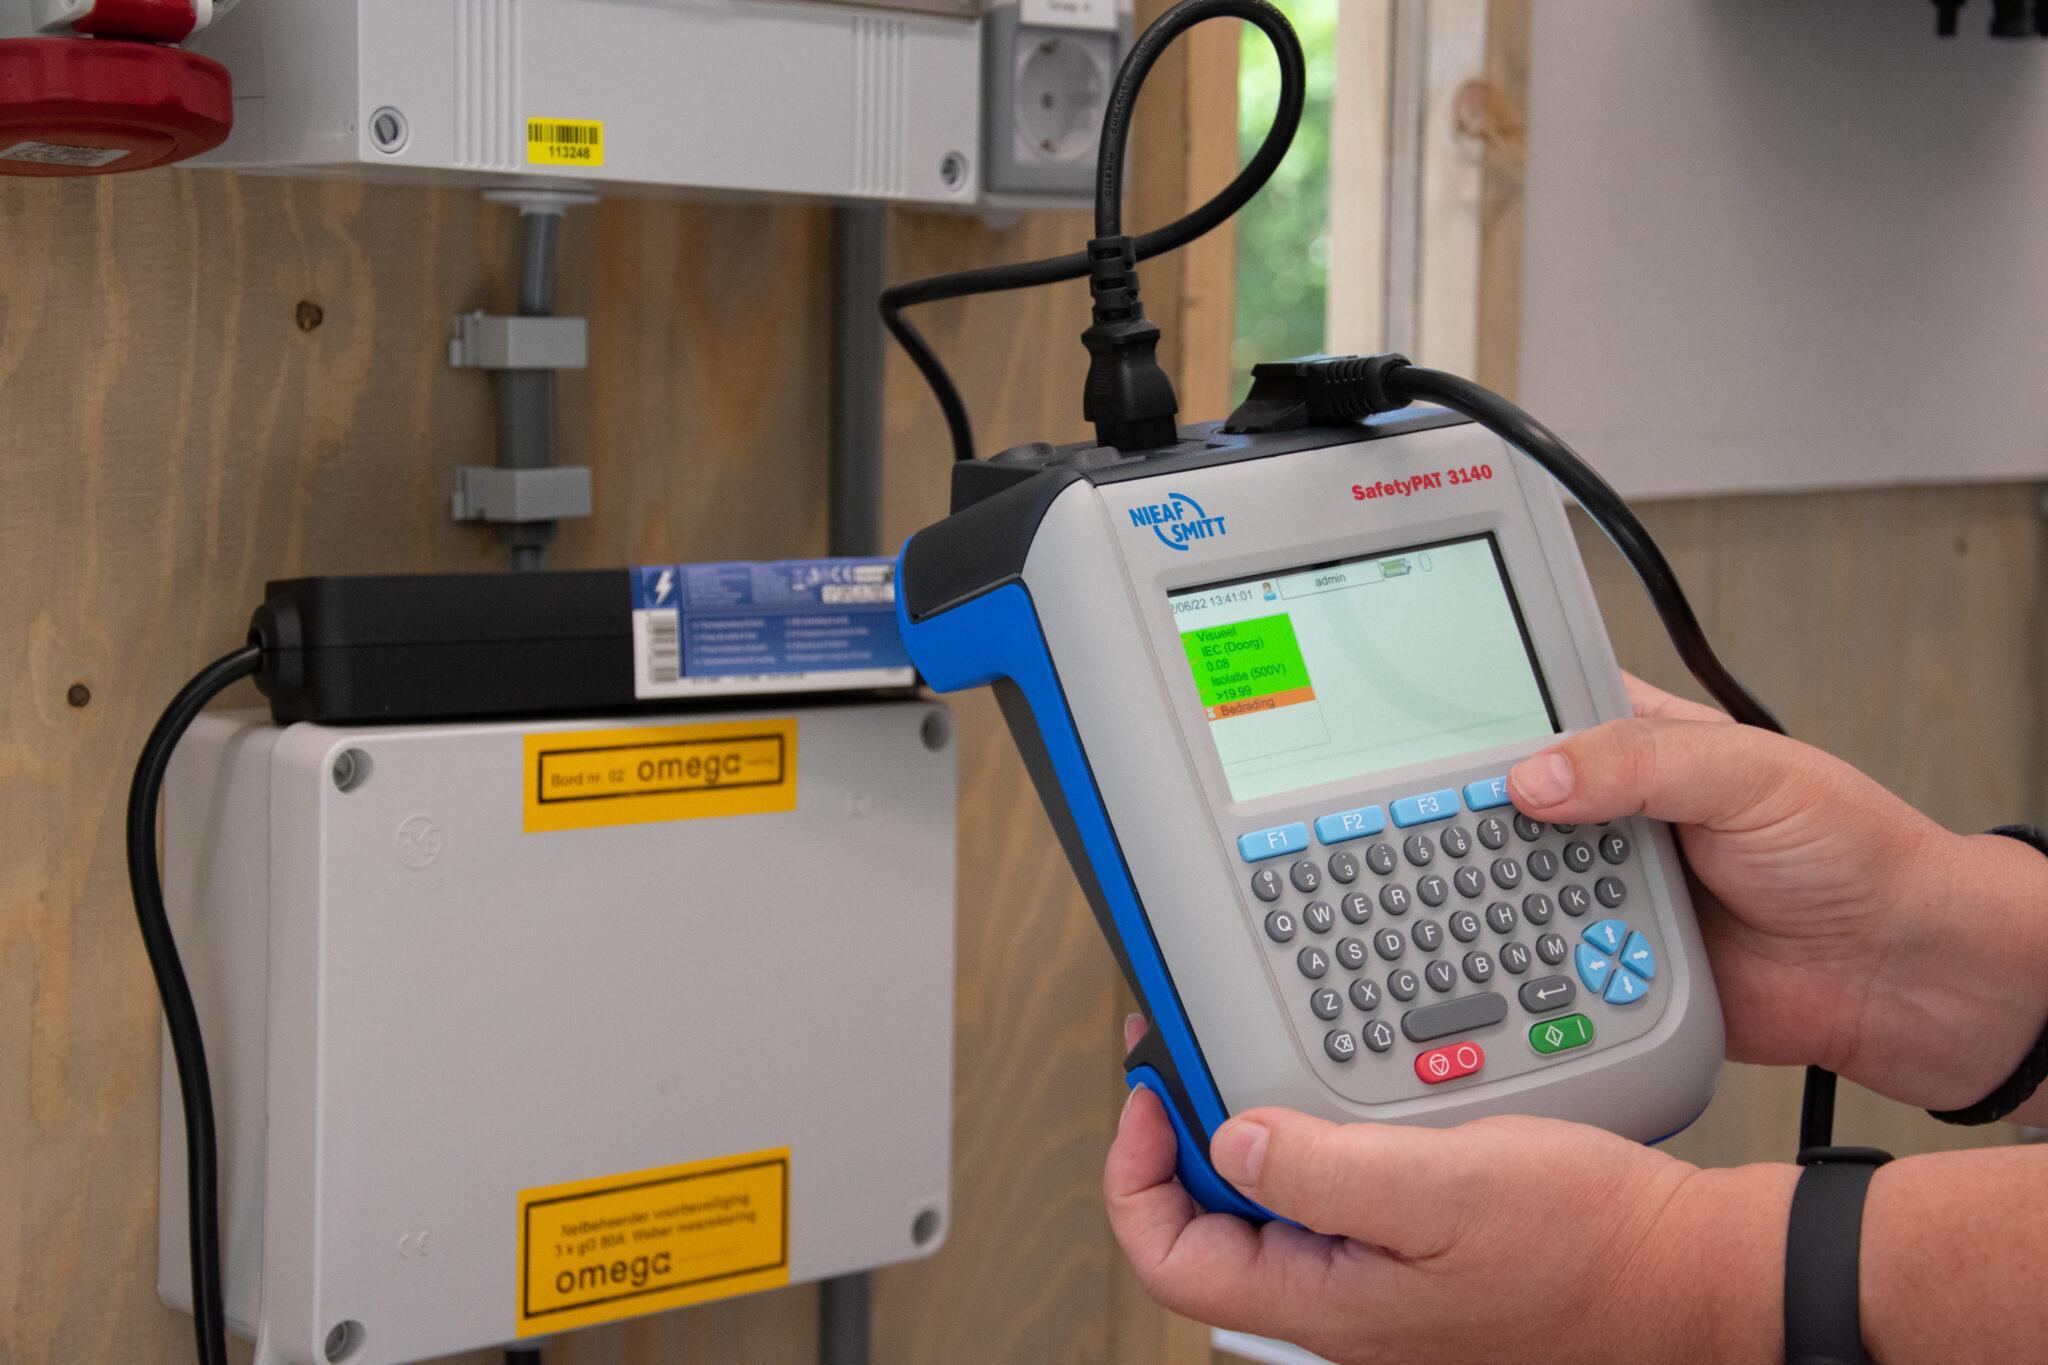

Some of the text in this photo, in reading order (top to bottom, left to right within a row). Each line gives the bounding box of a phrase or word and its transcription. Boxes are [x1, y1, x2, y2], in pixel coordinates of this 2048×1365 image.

[548, 146, 590, 159] 113248
[1351, 464, 1493, 501] SafetyPAT 3140
[1129, 501, 1184, 528] NIEAF
[1171, 516, 1227, 543] SMITT
[1315, 573, 1346, 587] admin
[1211, 590, 1253, 606] 13:41:01
[1196, 627, 1237, 642] Visueel
[1202, 637, 1264, 657] IEC (Doorg)
[1206, 658, 1230, 672] 0.08
[1211, 663, 1286, 686] Isolatie (500V)
[1216, 685, 1252, 699] >19.99
[1221, 698, 1275, 716] Bedrading
[551, 772, 583, 788] Bord
[607, 767, 624, 783] 02
[637, 753, 742, 786] omega
[1267, 831, 1288, 849] F1
[1342, 813, 1365, 832] F2
[1417, 796, 1440, 815] F3
[1268, 823, 1540, 894] 1 2 3 4 5 6 7 8
[1276, 839, 1624, 932] Q W E R T Y U I O P
[1312, 883, 1621, 970] A S D F G H J K L
[1323, 938, 1564, 1011] Z X C V B N M
[556, 1251, 671, 1294] omega
